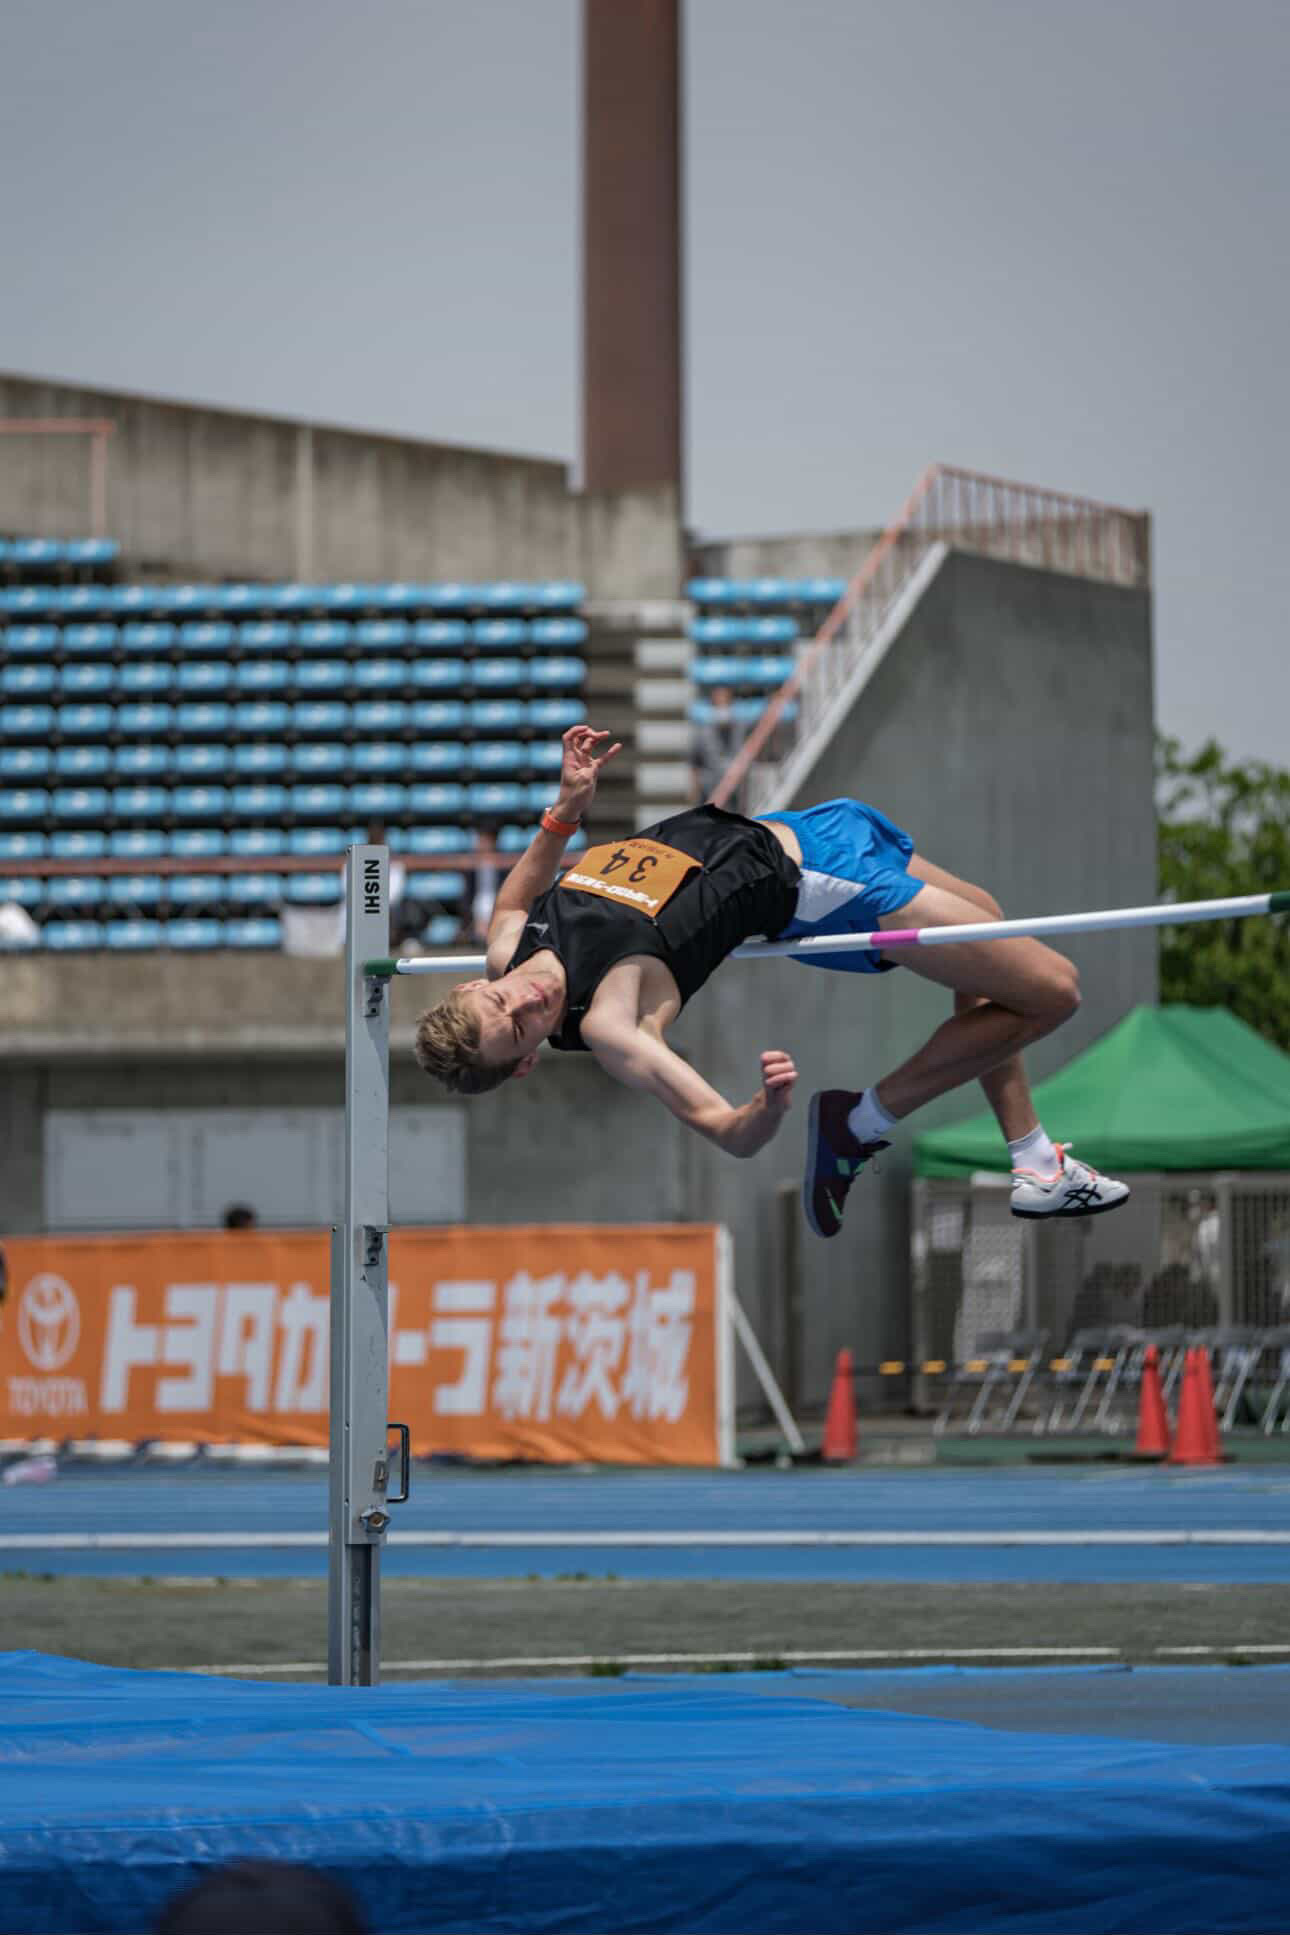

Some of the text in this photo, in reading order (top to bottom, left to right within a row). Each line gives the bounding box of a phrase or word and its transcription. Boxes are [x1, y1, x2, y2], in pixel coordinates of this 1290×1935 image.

[364, 859, 380, 914] NISHI
[600, 848, 657, 882] 34
[100, 1270, 696, 1419] トヨタカーラ新茨城
